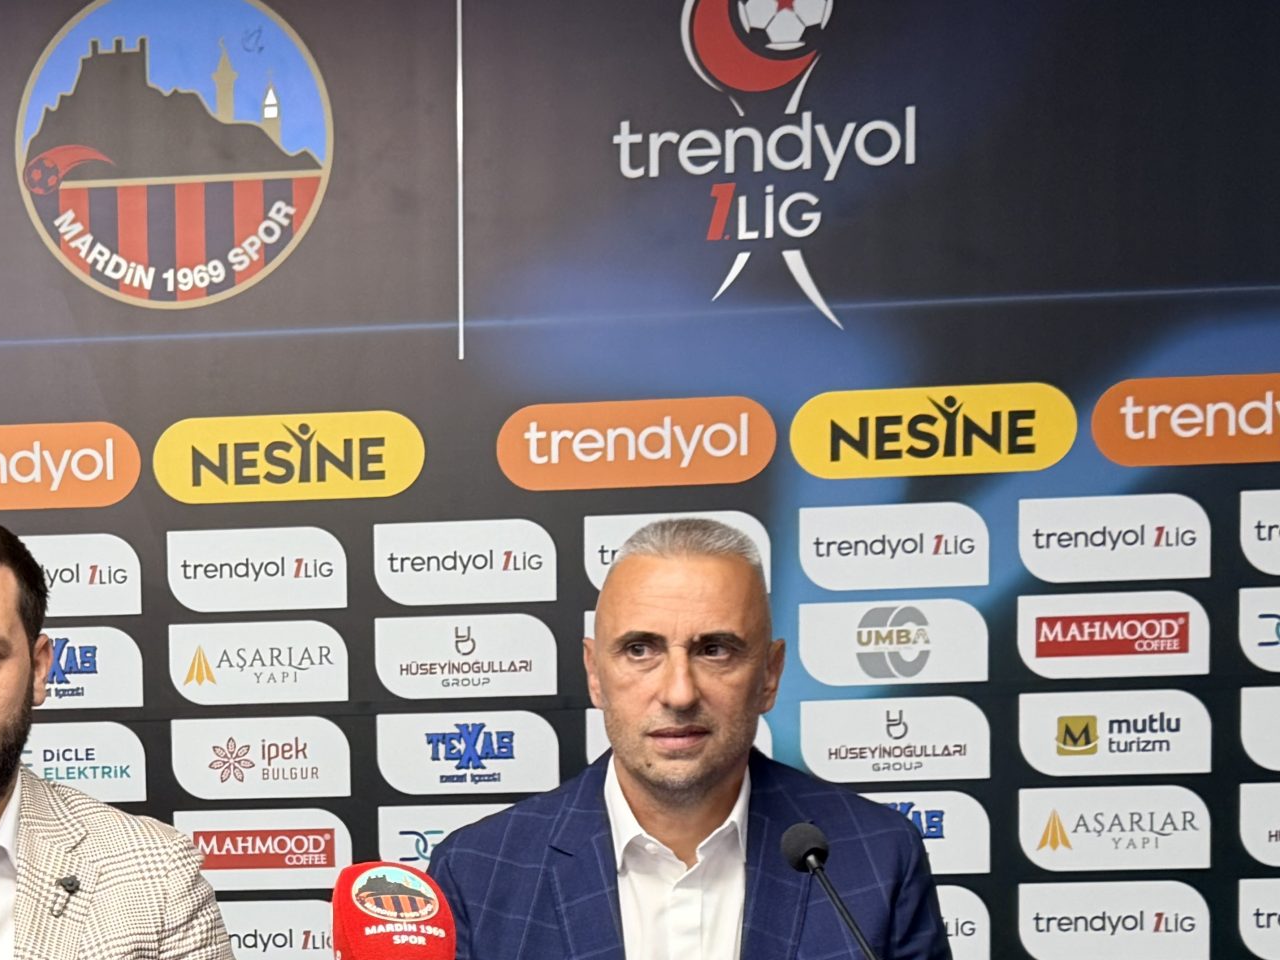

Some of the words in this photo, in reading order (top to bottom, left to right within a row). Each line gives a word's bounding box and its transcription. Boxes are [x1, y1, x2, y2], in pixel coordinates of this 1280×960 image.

[613, 106, 916, 181] trendyol
[162, 259, 226, 292] 1969
[227, 200, 297, 272] SPOR
[1120, 390, 1280, 440] trend
[524, 413, 749, 467] trendyol
[813, 534, 924, 559] trendyol
[1032, 525, 1145, 551] trendyol
[181, 556, 285, 582] trendyol
[388, 549, 494, 575] trendyol
[1134, 639, 1180, 652] COFFEE
[48, 637, 98, 684] XAS
[216, 646, 335, 671] AŞARLAR
[254, 671, 298, 684] YAPI
[442, 677, 490, 687] GROUP
[1108, 712, 1181, 734] mutlu
[261, 736, 308, 767] ipek
[425, 722, 515, 770] TEXAS
[1108, 737, 1171, 753] turizm
[261, 766, 320, 780] BULGUR
[872, 762, 923, 772] GROUP
[1072, 811, 1200, 837] AŞARLAR
[1112, 837, 1160, 850] YAPI
[285, 853, 328, 865] COFFEE
[419, 924, 446, 938] 1969
[1033, 911, 1144, 935] trendyol
[228, 928, 293, 952] ndyol
[392, 934, 427, 945] SPOR
